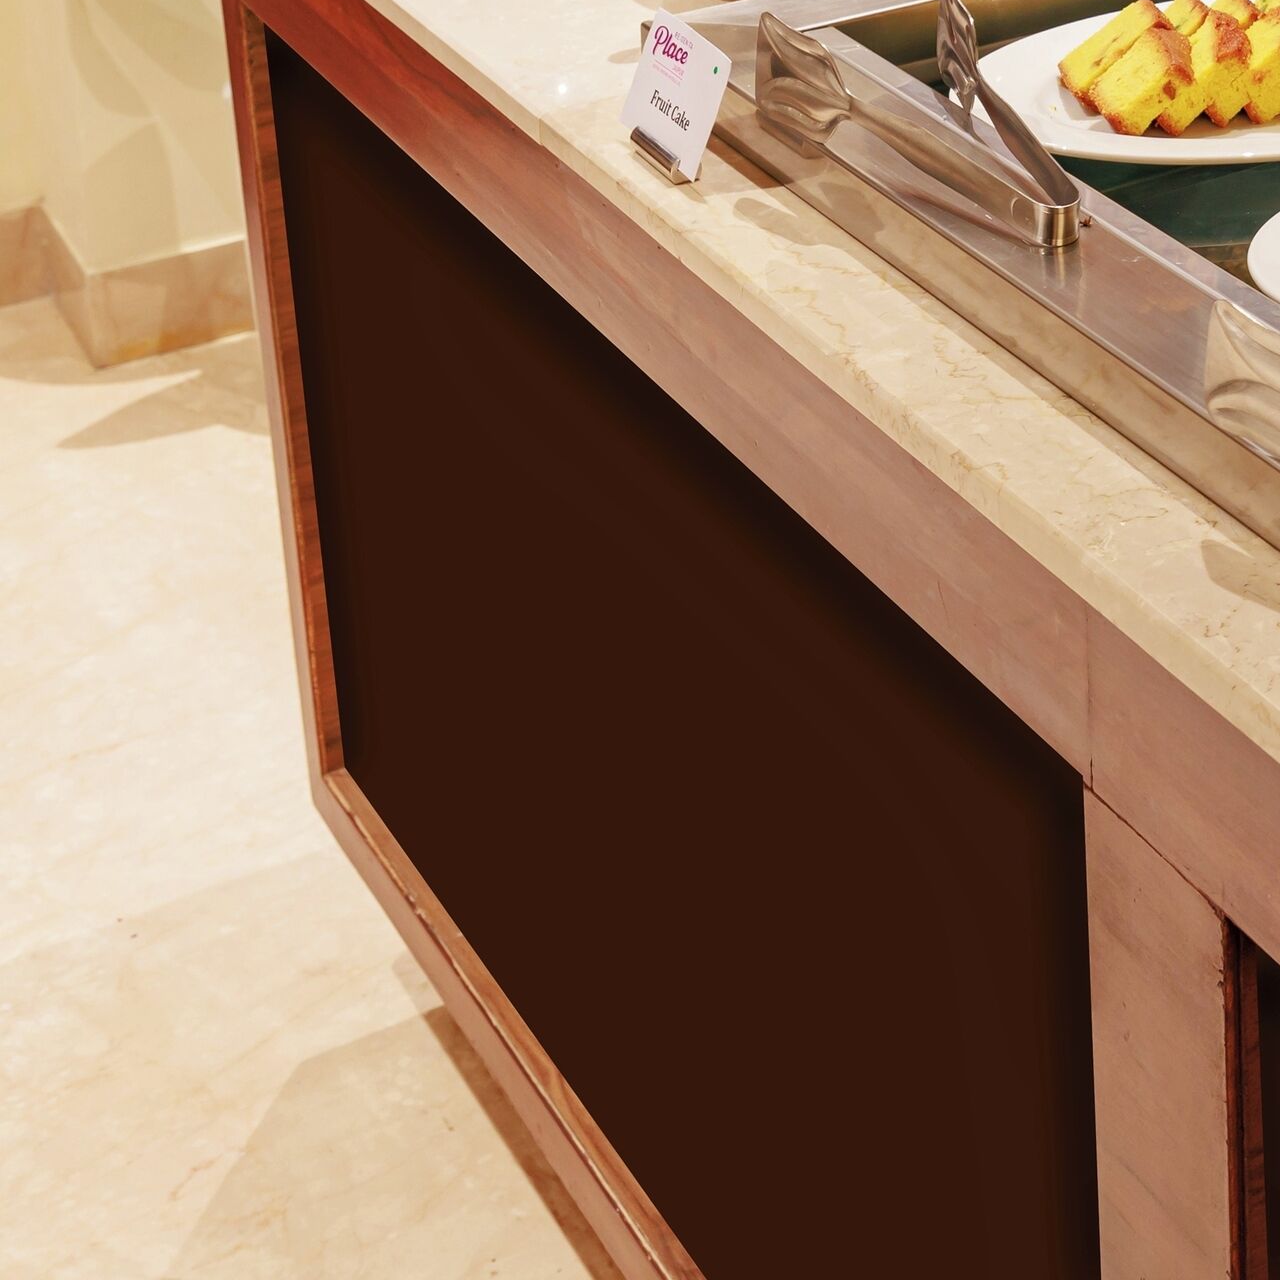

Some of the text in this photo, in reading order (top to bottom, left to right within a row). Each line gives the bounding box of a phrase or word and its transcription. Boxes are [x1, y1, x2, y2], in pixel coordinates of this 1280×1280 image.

[652, 25, 689, 65] Place
[650, 89, 690, 131] Fruit Cake
